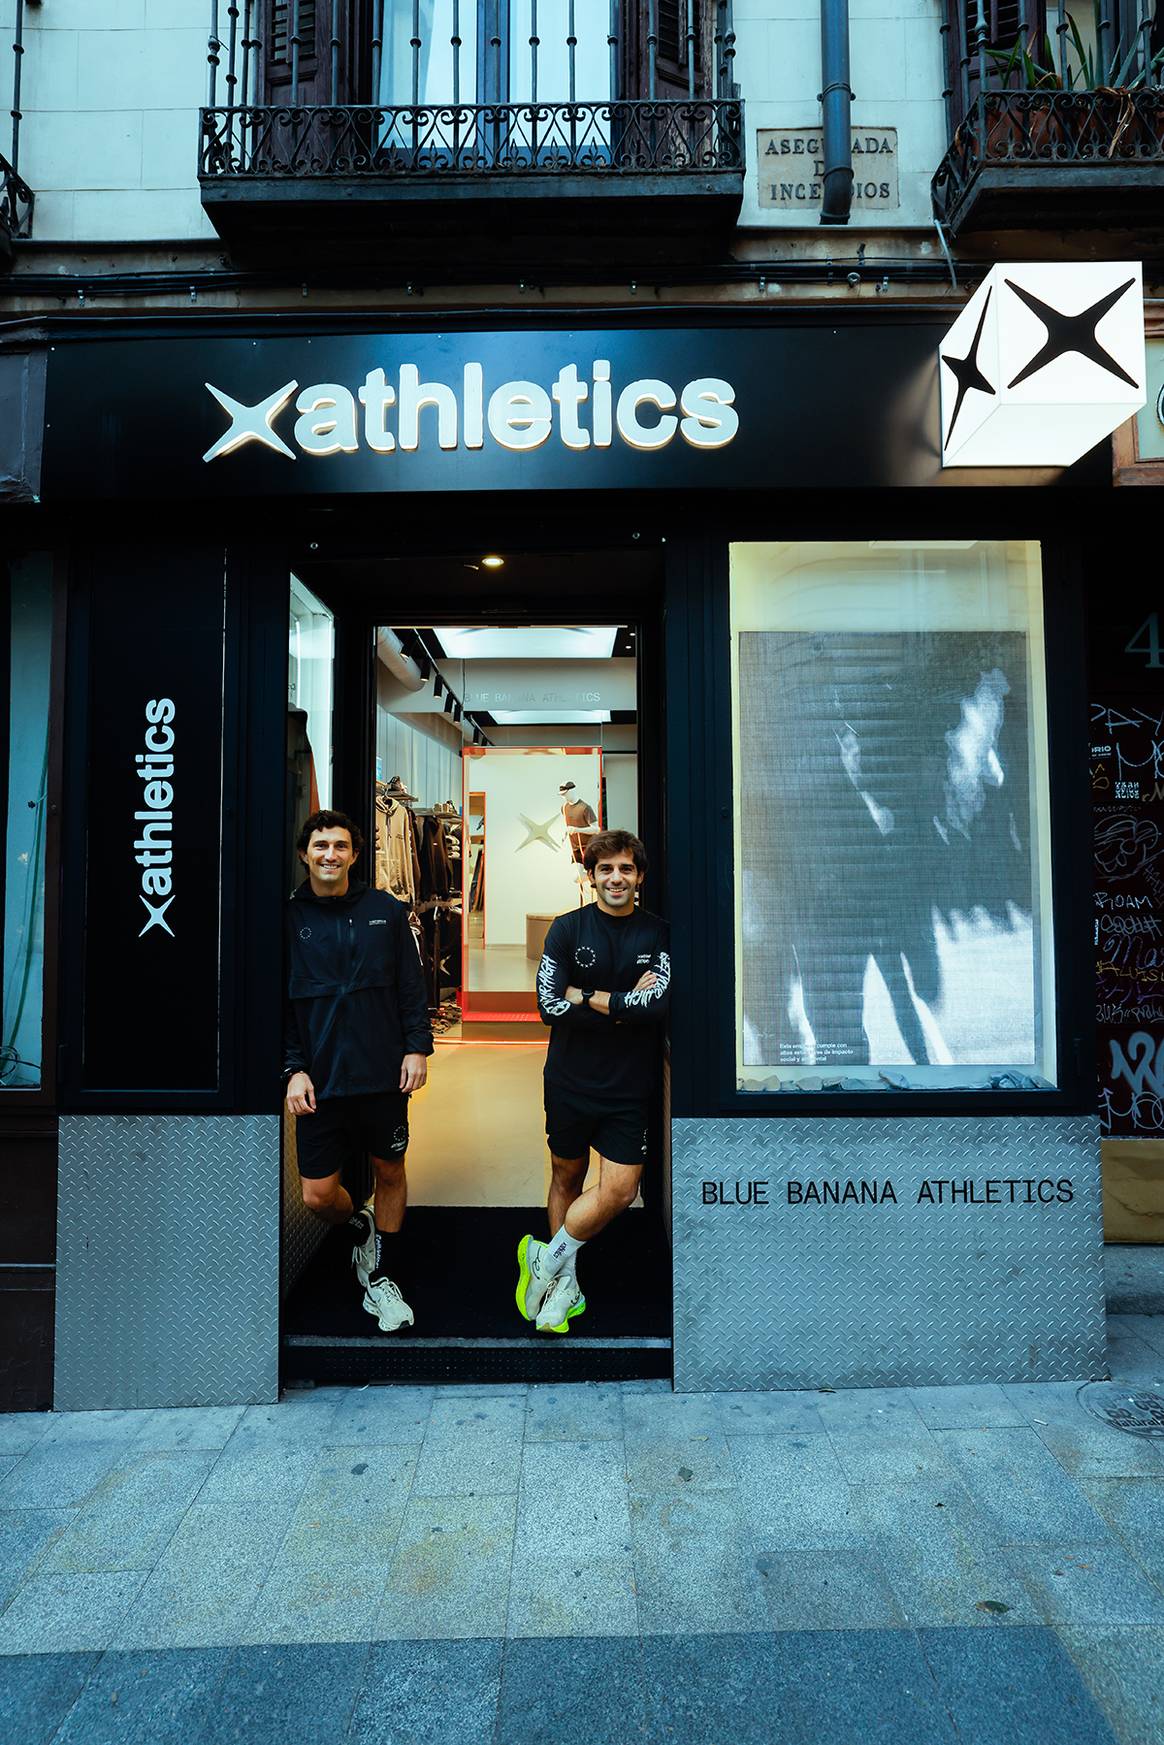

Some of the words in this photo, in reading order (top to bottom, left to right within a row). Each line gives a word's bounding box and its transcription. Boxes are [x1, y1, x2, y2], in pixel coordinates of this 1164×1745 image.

[765, 138, 893, 155] ASEGADA
[770, 182, 890, 200] INCEIOS
[702, 1181, 769, 1205] BLUE
[788, 1180, 898, 1205] BANANA
[917, 1179, 1074, 1204] ATHLETICS
